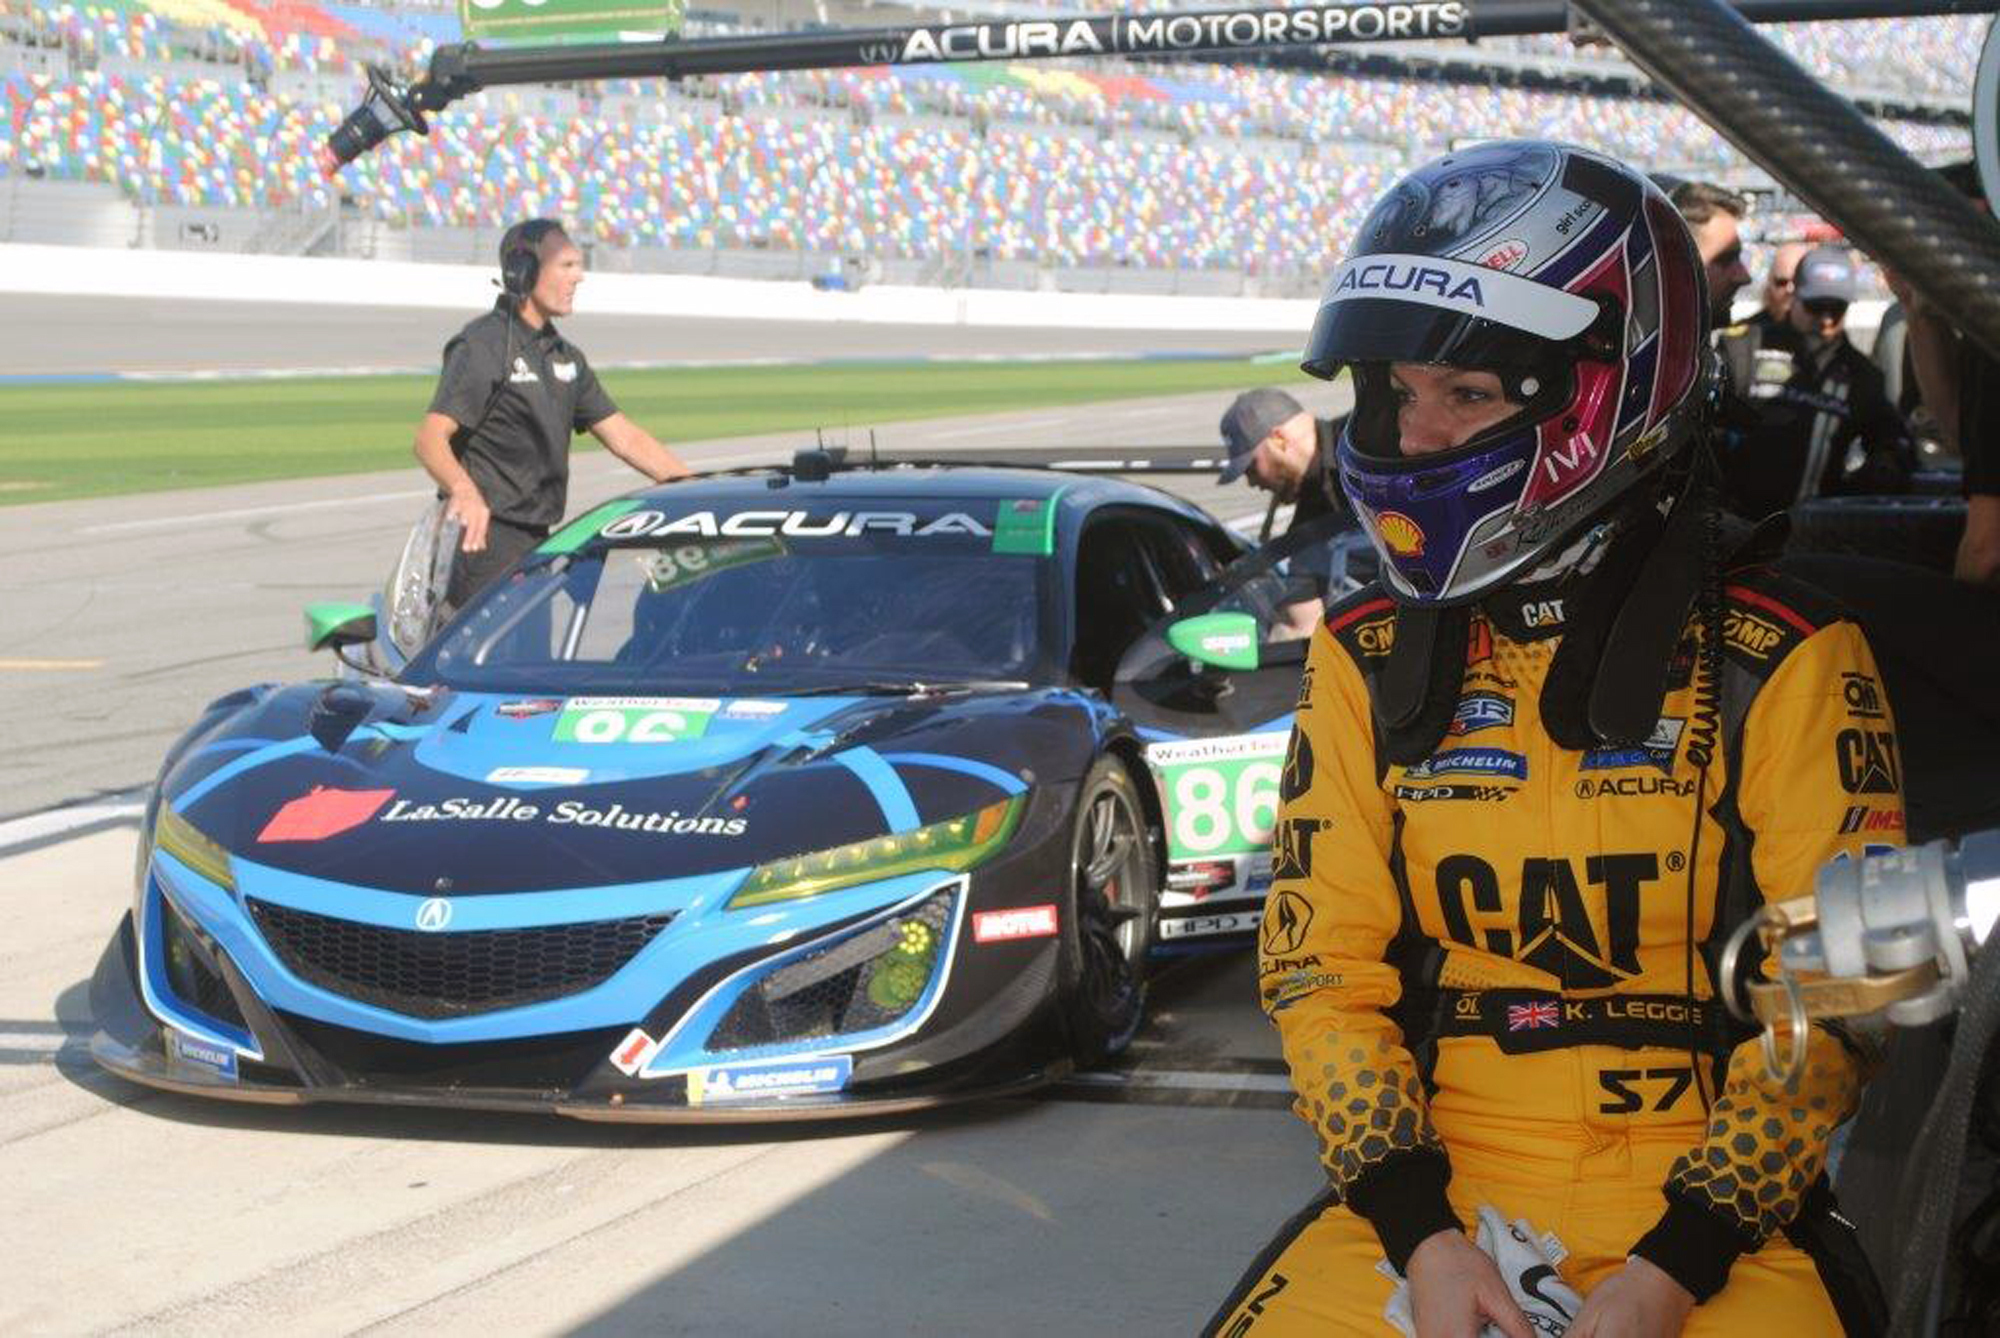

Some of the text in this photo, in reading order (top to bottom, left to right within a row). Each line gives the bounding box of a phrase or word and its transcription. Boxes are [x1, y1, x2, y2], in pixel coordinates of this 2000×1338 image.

[902, 1, 1469, 62] ACURA MOTORSPORTS
[1555, 212, 1577, 236] girl
[1335, 263, 1486, 308] ACURA
[649, 510, 992, 538] ACURA
[1521, 599, 1567, 628] CAT
[1432, 755, 1519, 772] MICHELIN
[1597, 776, 1698, 798] ACURA
[380, 798, 751, 836] LaSalle Solutions
[1174, 762, 1283, 851] 86
